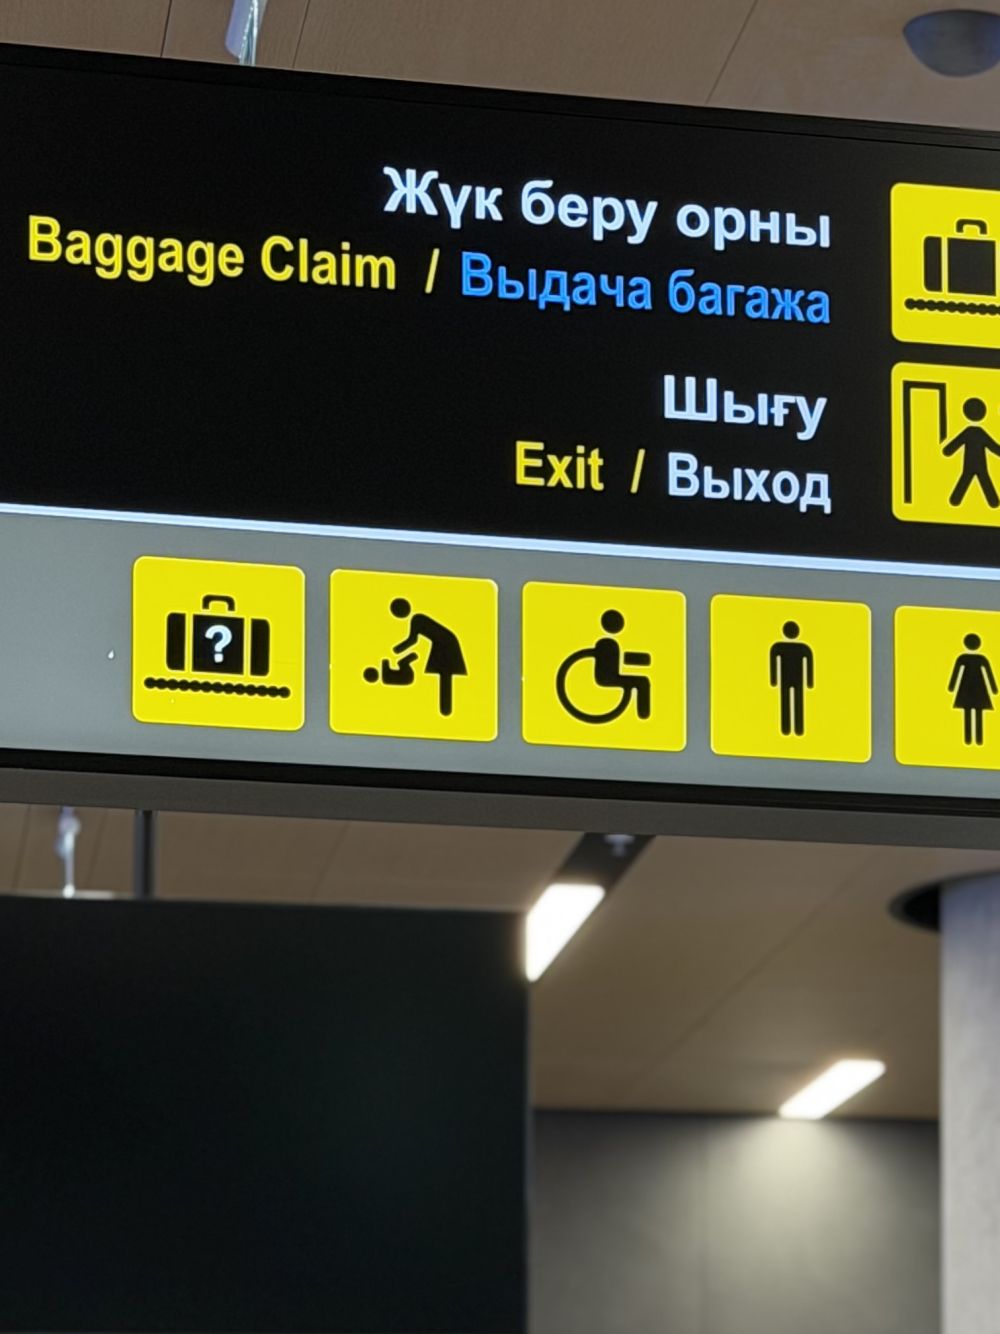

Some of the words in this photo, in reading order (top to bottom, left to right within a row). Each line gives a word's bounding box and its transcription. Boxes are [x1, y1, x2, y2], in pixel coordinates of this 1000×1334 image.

[383, 165, 503, 230] Жүк
[520, 179, 658, 245] беру
[676, 203, 831, 251] орны
[28, 214, 245, 287] Baggage
[260, 235, 396, 290] Claim
[425, 248, 440, 294] /
[461, 251, 653, 312] Выдача
[667, 268, 831, 324] багажа
[663, 374, 828, 441] Шығу
[515, 440, 605, 491] Exit
[630, 448, 646, 494] /
[667, 451, 832, 515] Выход
